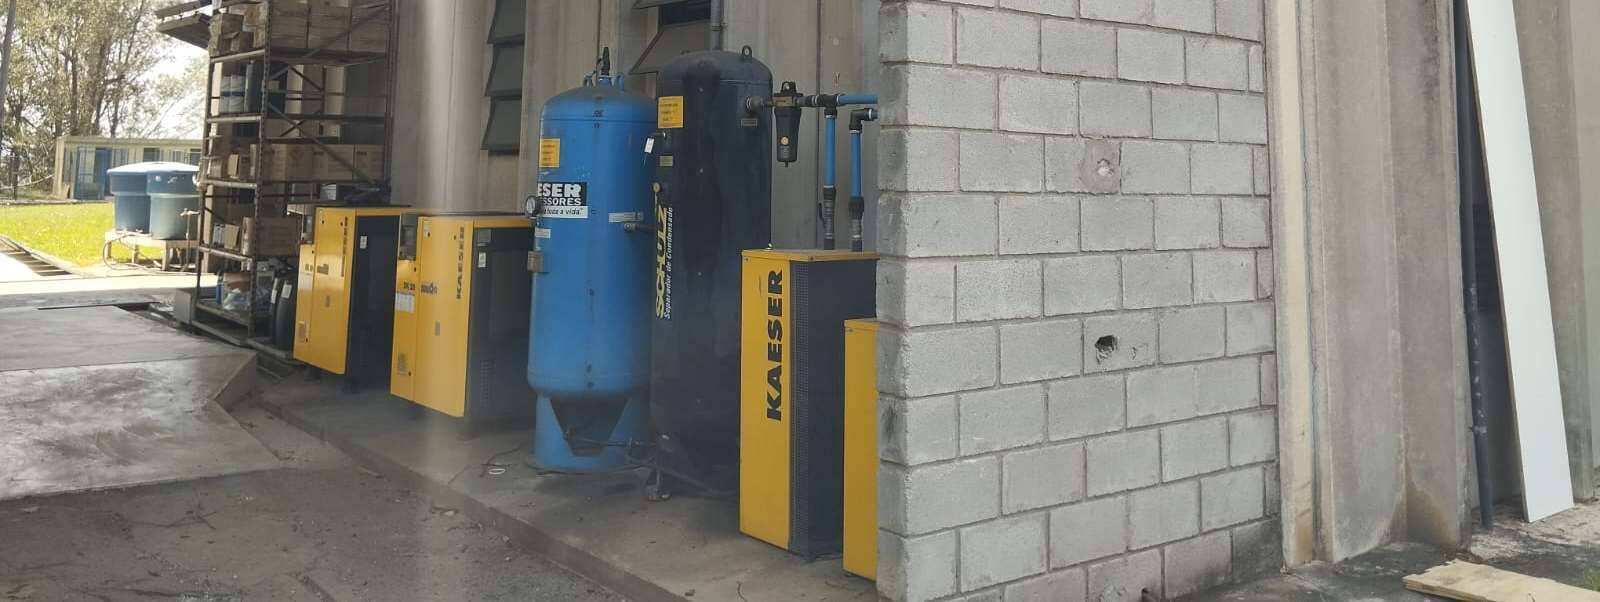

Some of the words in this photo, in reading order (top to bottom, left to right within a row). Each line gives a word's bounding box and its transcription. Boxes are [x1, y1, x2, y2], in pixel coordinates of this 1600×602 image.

[656, 205, 667, 319] SCHULZ
[666, 261, 672, 272] de
[767, 269, 783, 421] KAESER
